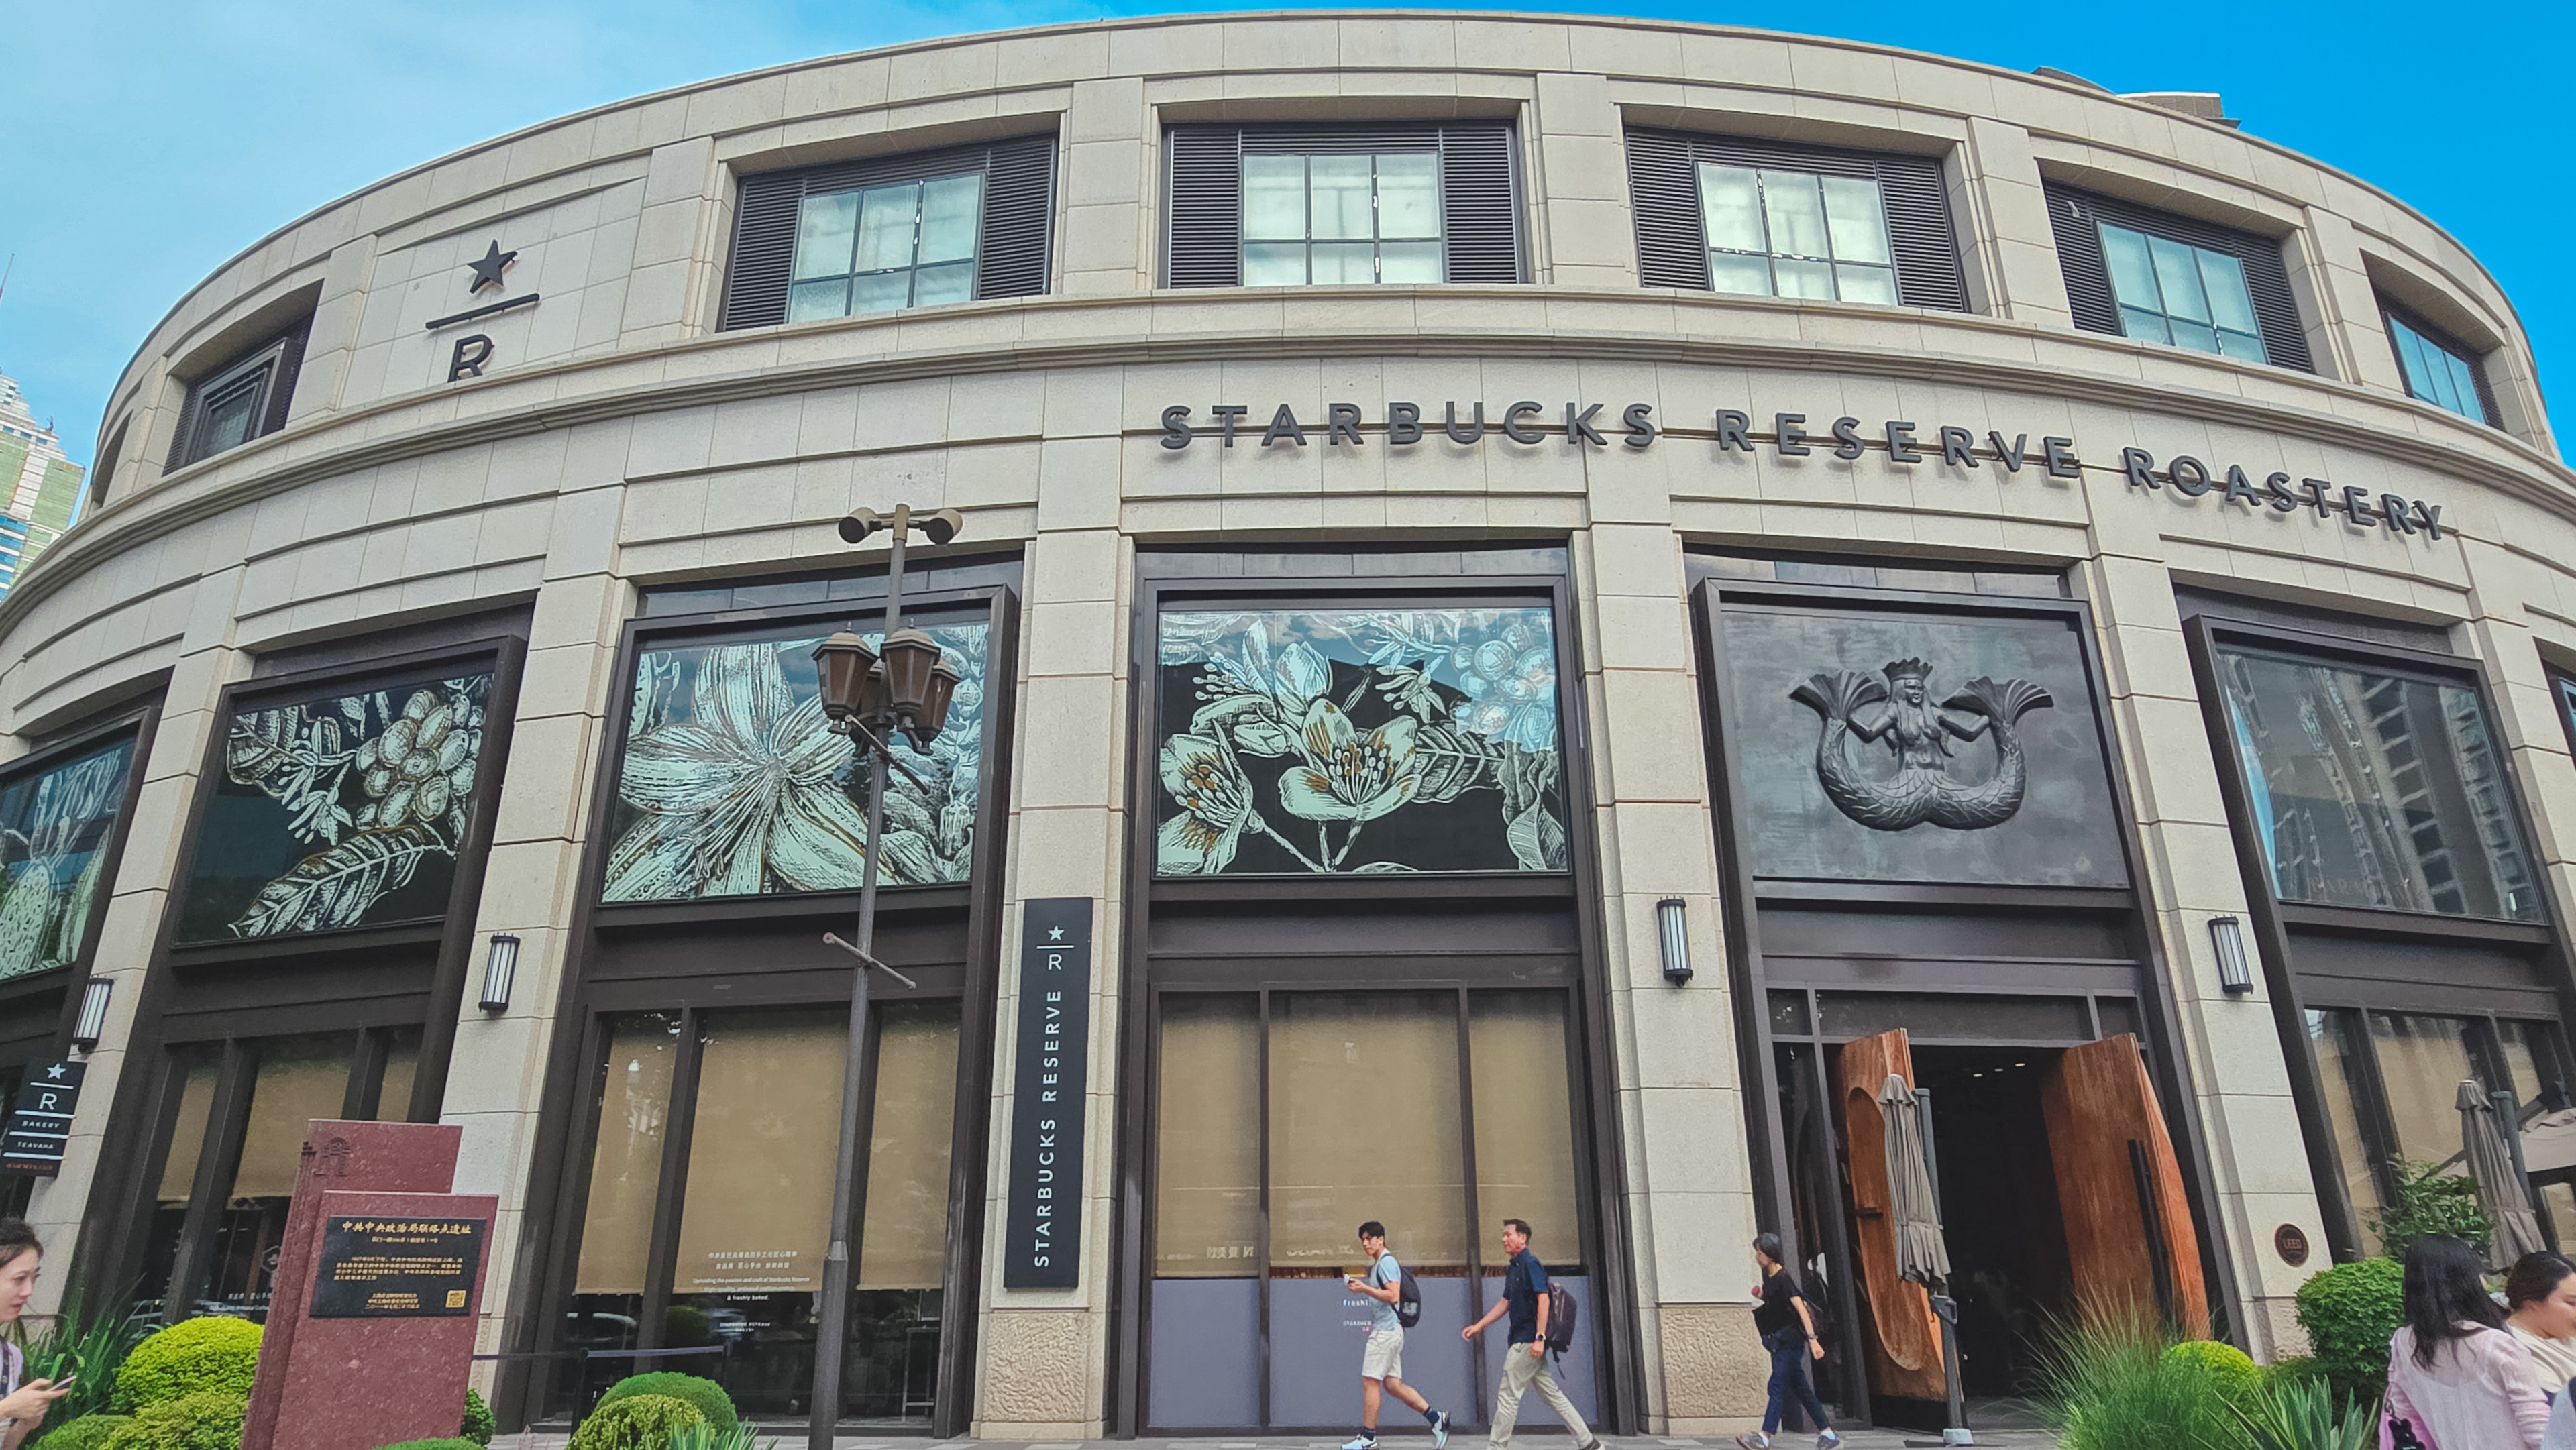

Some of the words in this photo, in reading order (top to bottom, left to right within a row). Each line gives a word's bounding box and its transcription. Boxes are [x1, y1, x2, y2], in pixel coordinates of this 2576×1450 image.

[448, 334, 493, 383] R
[1160, 401, 1656, 449] STARBUCKS
[1715, 408, 2081, 479] RESERVE
[2122, 445, 2444, 541] ROASTERY
[1048, 954, 1062, 970] R
[1042, 991, 1061, 1103] RESERVE
[21, 1120, 60, 1129] BAKERY
[38, 1093, 58, 1111] R
[1034, 1119, 1056, 1268] STARBUCKS
